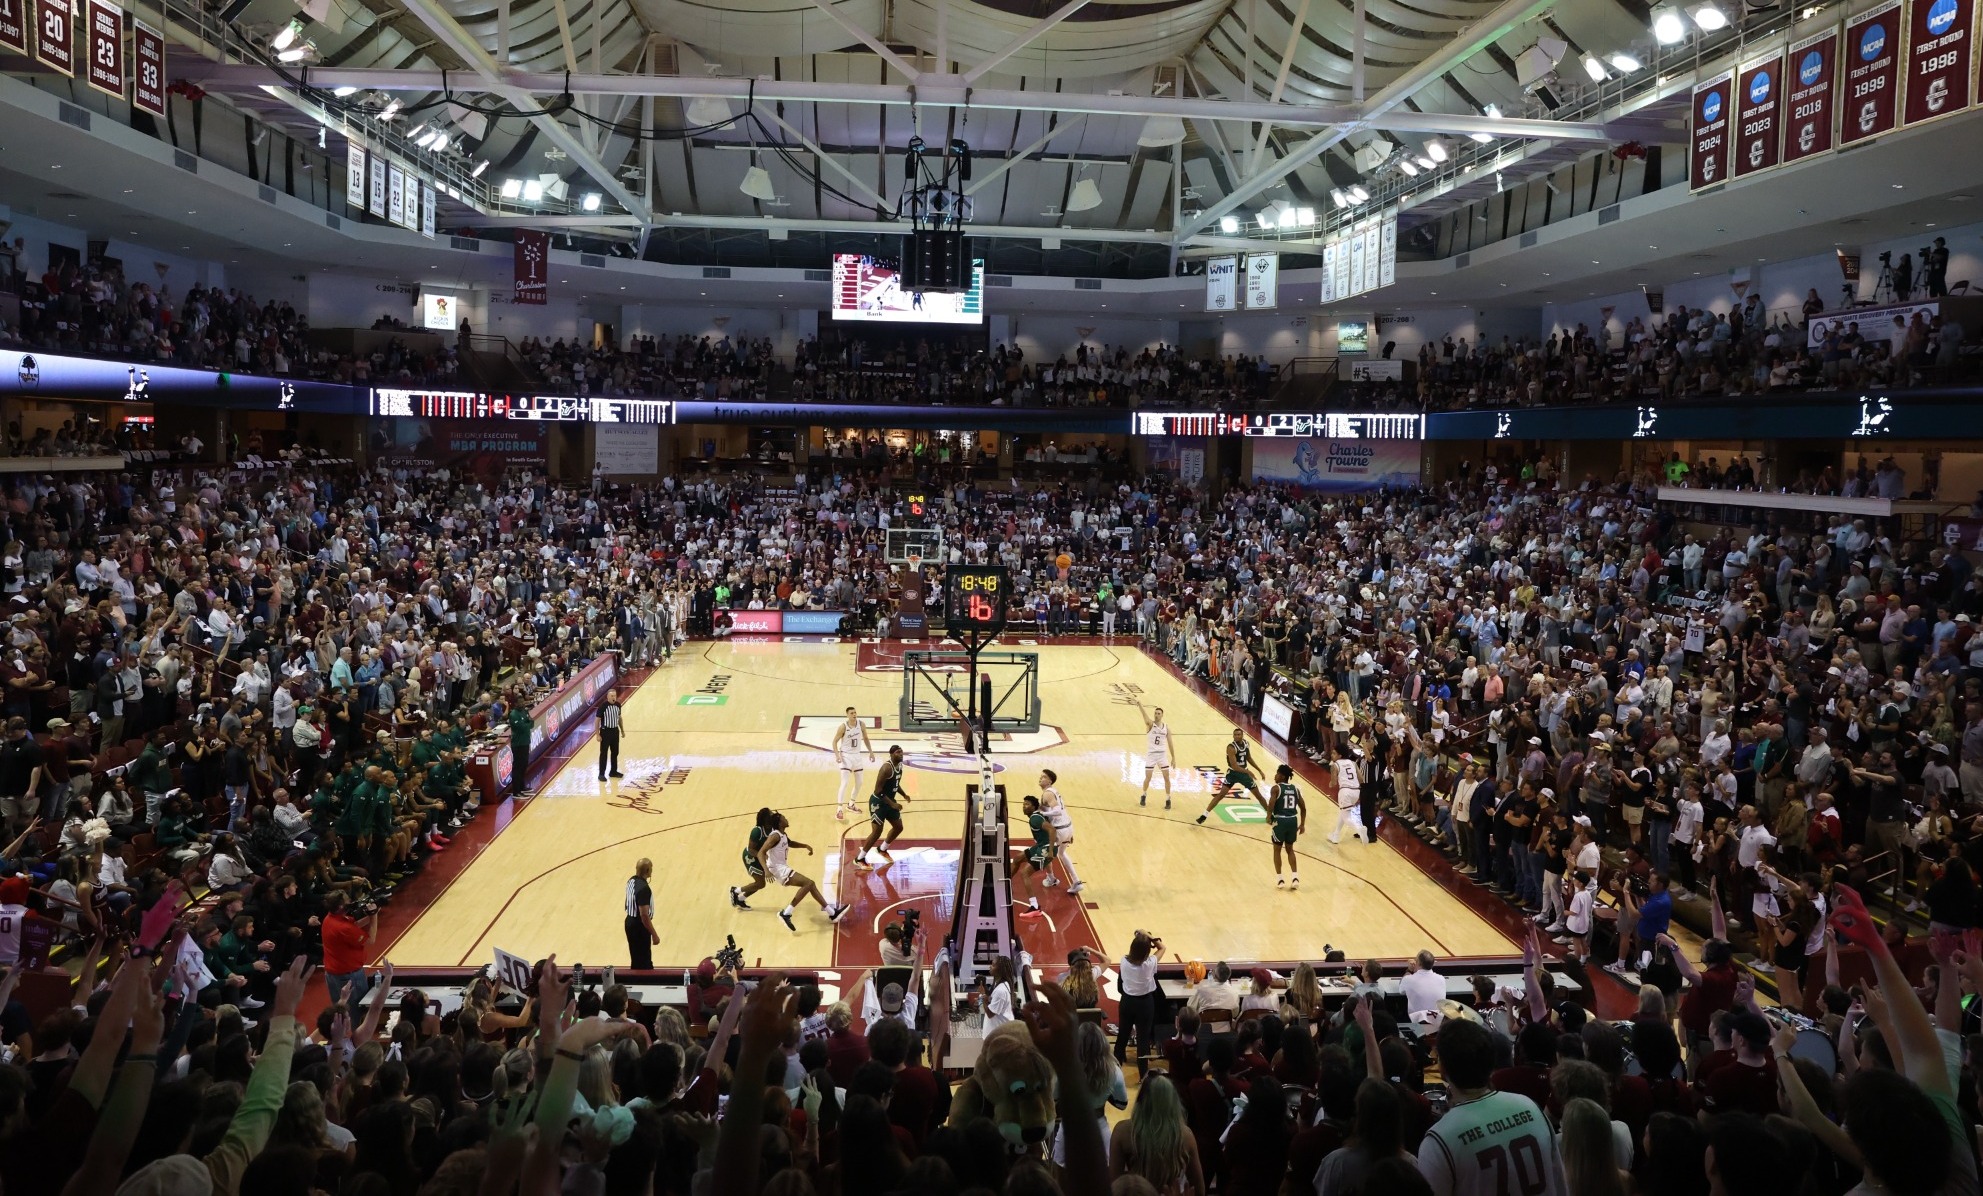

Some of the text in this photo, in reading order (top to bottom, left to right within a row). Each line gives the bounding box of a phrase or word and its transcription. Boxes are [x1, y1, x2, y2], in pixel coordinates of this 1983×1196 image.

[45, 9, 63, 43] 20
[1930, 10, 1957, 29] NCAA
[1862, 38, 1884, 55] NCAA
[1916, 29, 1964, 55] FIRST ROUND
[97, 38, 114, 68] 23
[1850, 56, 1891, 79] FIRST ROUND
[1920, 50, 1958, 75] 1998
[142, 61, 158, 90] 33
[1801, 64, 1822, 79] NCAA
[1751, 84, 1770, 99] NCAA
[1791, 81, 1828, 103] FIRST ROUND
[1854, 75, 1886, 98] 1999
[1704, 103, 1720, 117] NCAA
[1743, 107, 1757, 119] FIRST
[1795, 100, 1822, 119] 2018
[1696, 126, 1709, 137] FIRST
[1745, 117, 1771, 136] 2023
[1699, 135, 1721, 153] 2024
[1209, 264, 1235, 275] WNIT
[515, 280, 547, 291] Charleston
[519, 398, 528, 409] 0
[544, 399, 553, 411] 2
[714, 406, 750, 419] true
[1255, 415, 1263, 427] 0
[1280, 416, 1288, 427] 2
[483, 432, 519, 440] EXECUTIVE
[451, 440, 537, 452] MBA PROGRAM
[1329, 442, 1375, 457] Charles
[1325, 456, 1370, 473] Towne
[961, 575, 997, 591] 18:48
[969, 594, 992, 621] 16
[787, 615, 800, 623] The
[801, 615, 834, 625] Exchange
[1690, 629, 1699, 638] 70
[696, 674, 732, 694] Arena
[1154, 735, 1161, 745] 6
[1345, 767, 1354, 780] 5
[1283, 795, 1296, 809] 13
[1458, 1109, 1534, 1146] THE COLLEGE
[1475, 1133, 1547, 1196] 70
